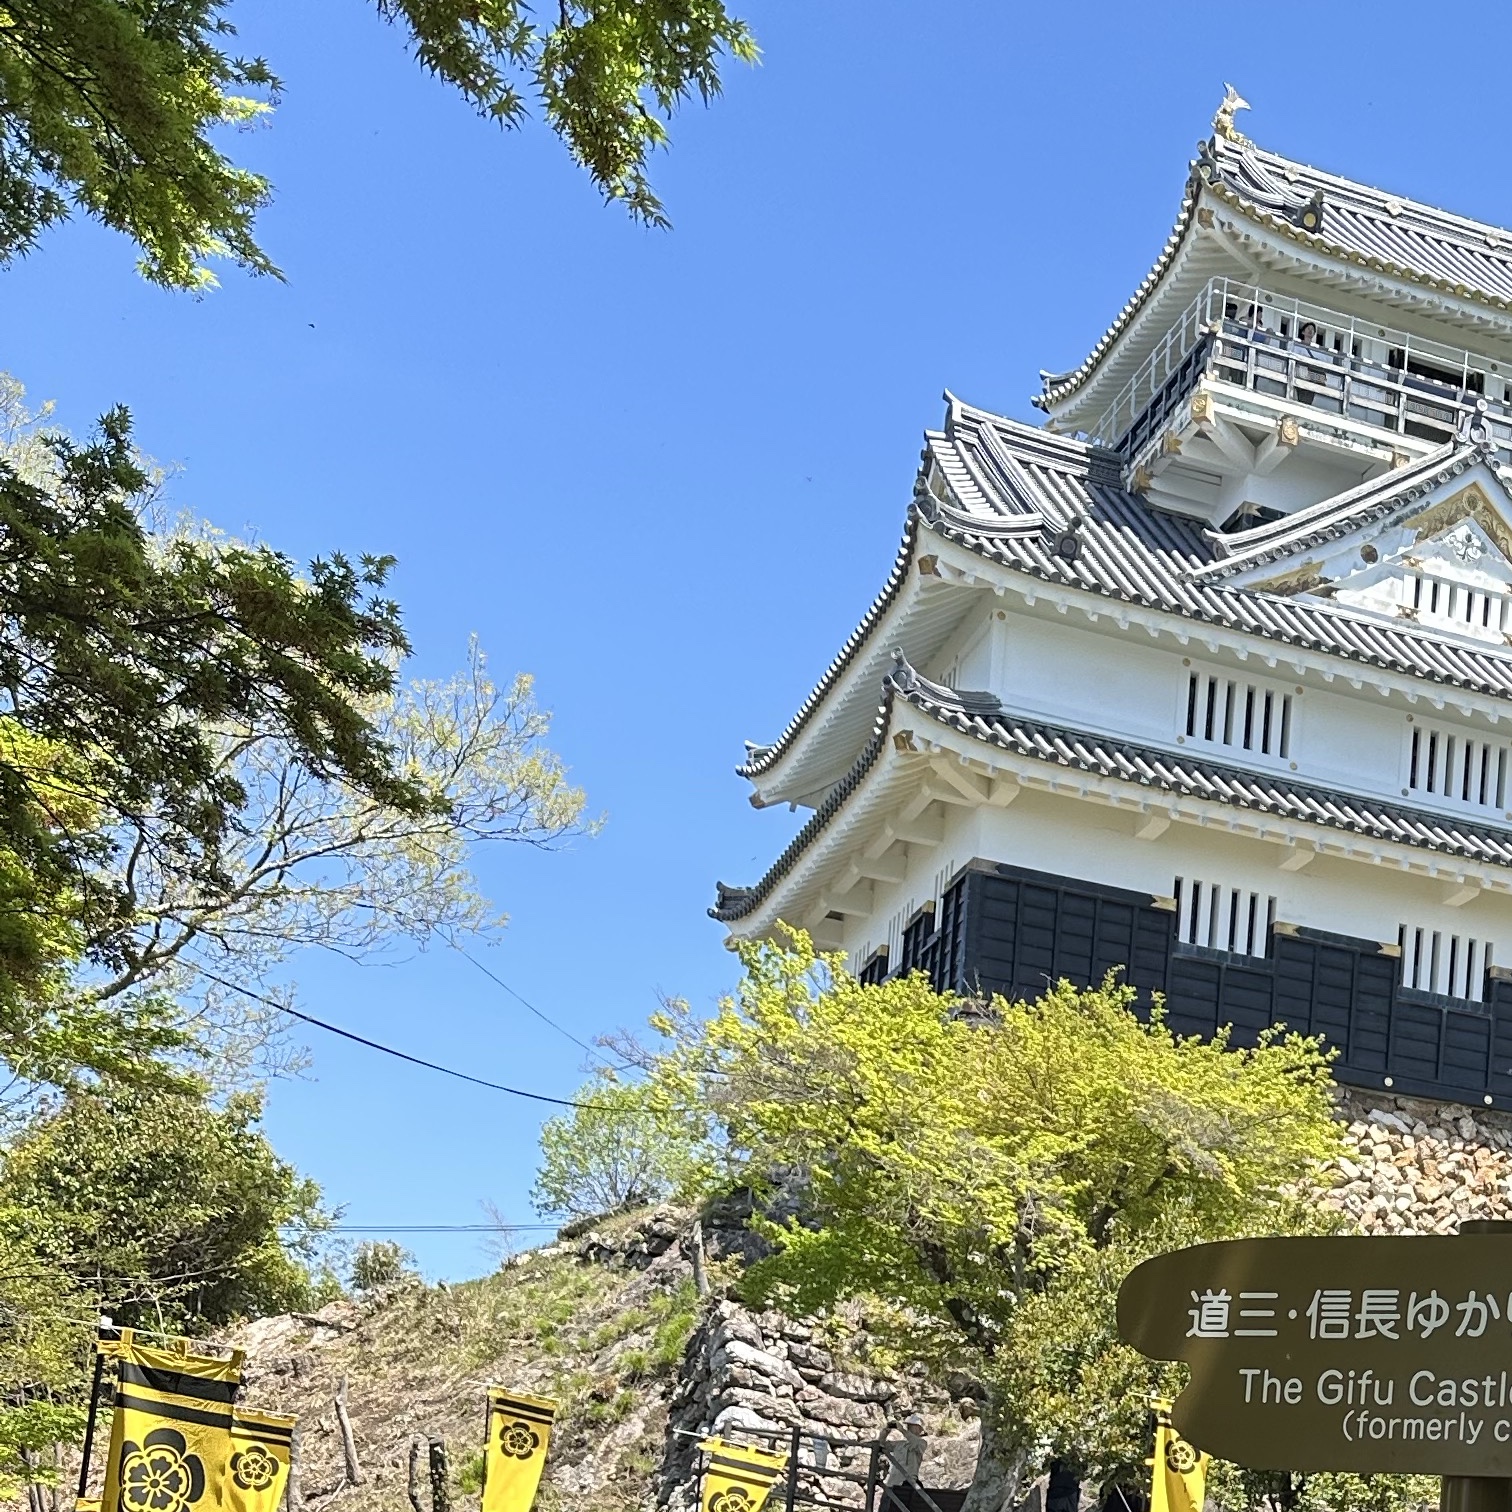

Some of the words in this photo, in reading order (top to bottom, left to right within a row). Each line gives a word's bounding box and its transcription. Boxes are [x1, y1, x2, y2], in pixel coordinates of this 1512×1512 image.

[1238, 1368, 1304, 1405] The
[1317, 1369, 1394, 1405] Gifu
[1342, 1409, 1484, 1445] (formerly
